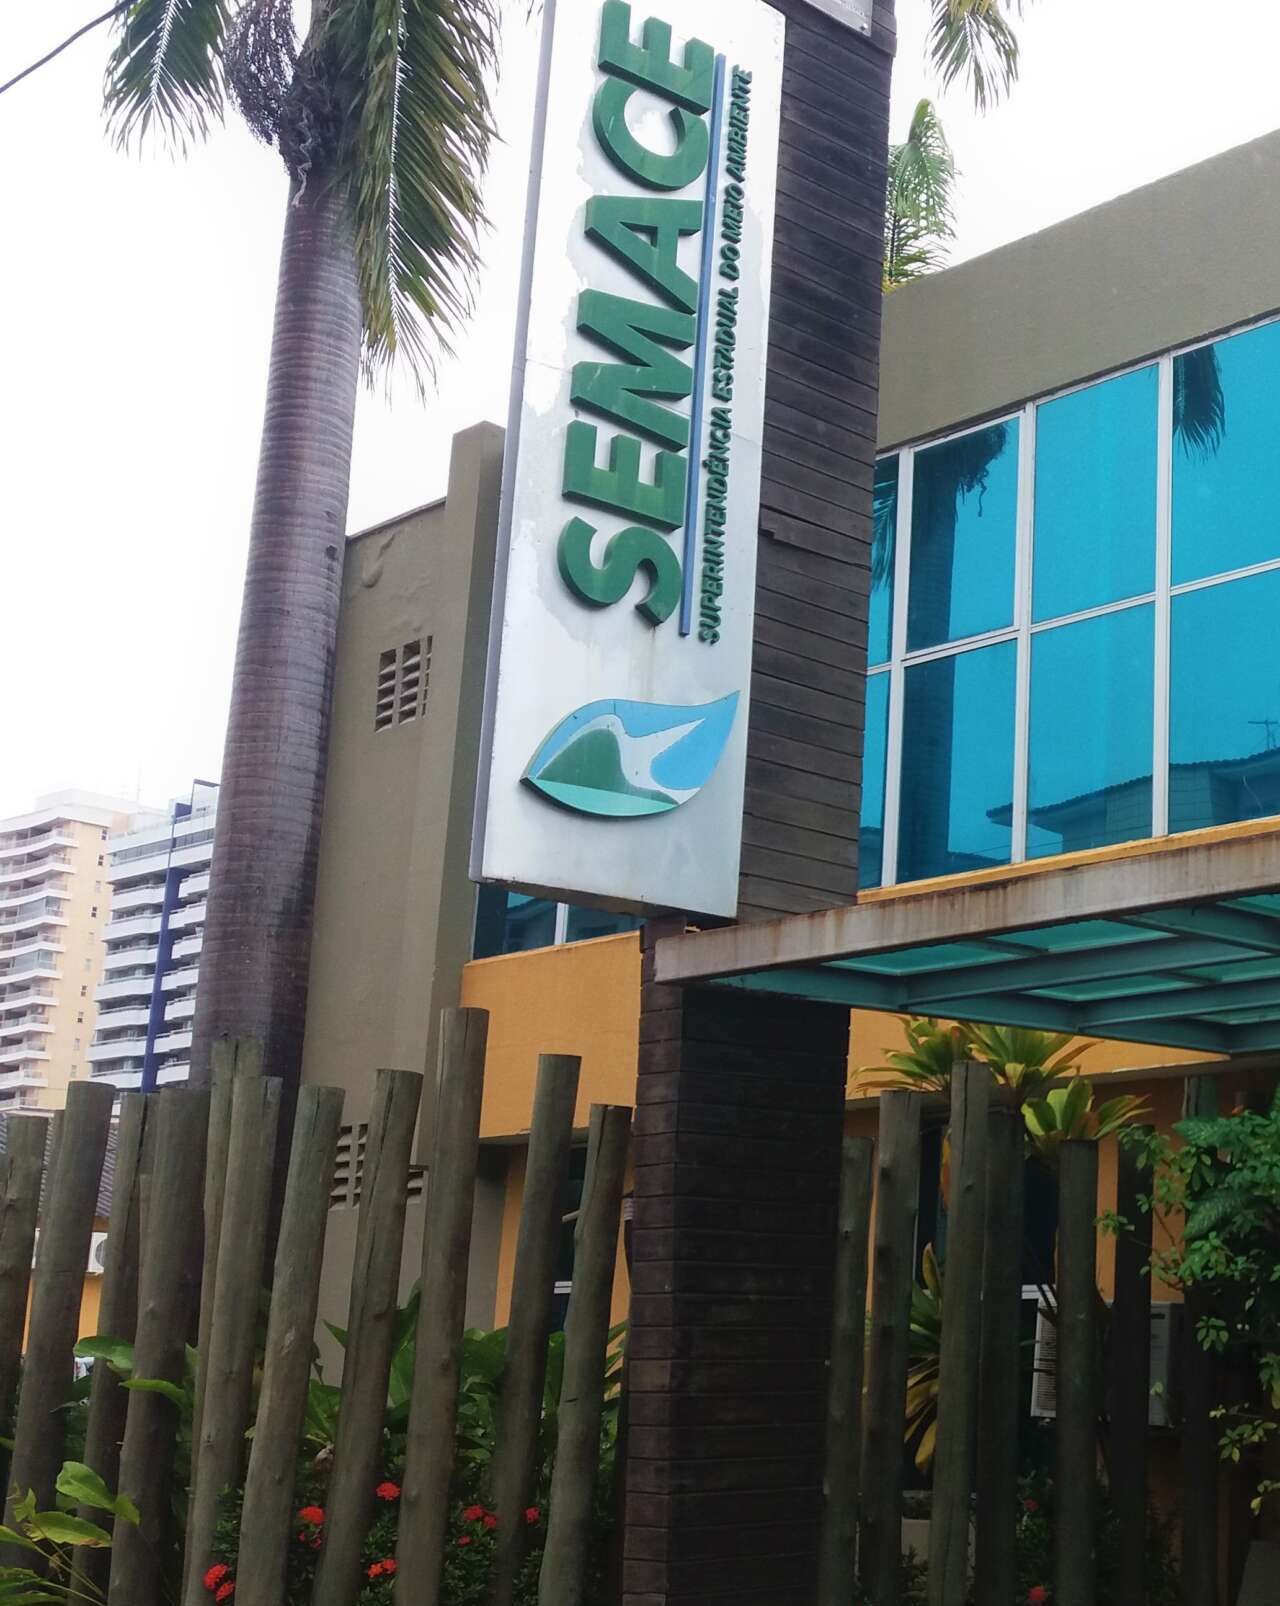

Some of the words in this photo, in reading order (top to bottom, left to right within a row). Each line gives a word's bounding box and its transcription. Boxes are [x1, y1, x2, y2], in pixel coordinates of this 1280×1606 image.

[726, 64, 752, 183] AMBIENTE
[719, 243, 740, 281] DO
[721, 182, 745, 244] MEIO
[557, 0, 714, 627] SEMACE
[712, 286, 739, 402] ESTADUAL
[698, 406, 732, 645] SUPERINTENDÊNCIA
